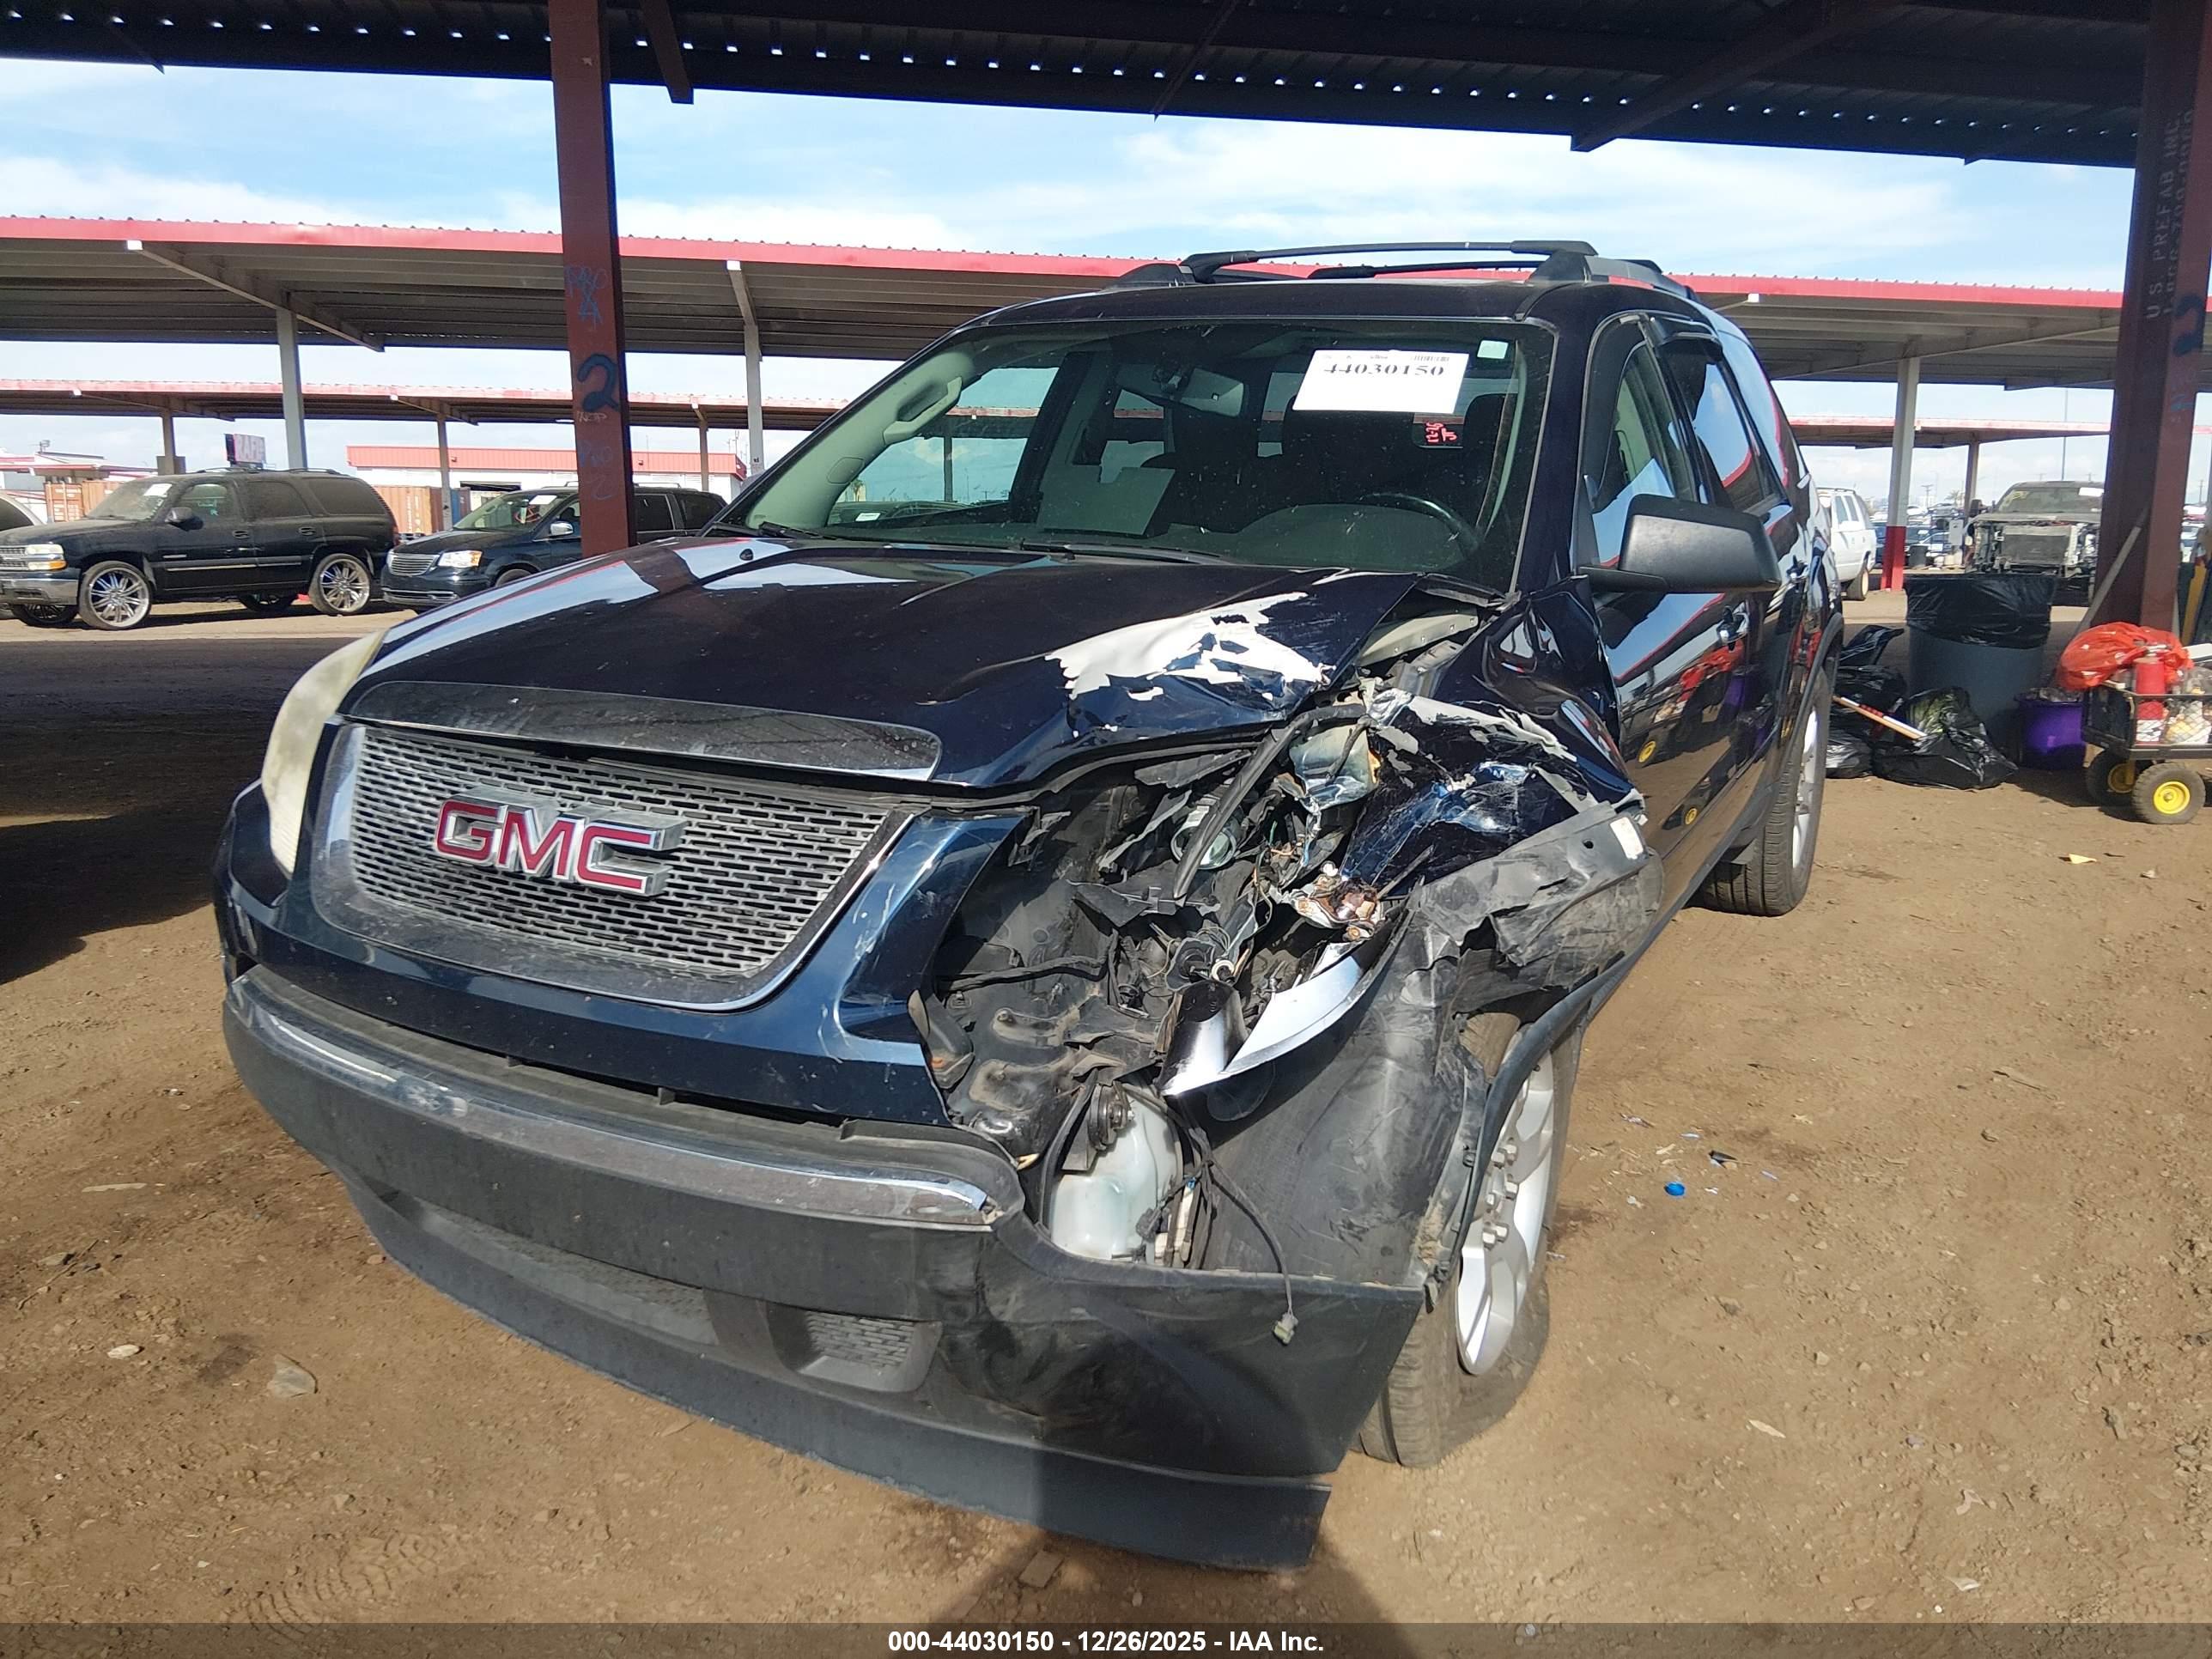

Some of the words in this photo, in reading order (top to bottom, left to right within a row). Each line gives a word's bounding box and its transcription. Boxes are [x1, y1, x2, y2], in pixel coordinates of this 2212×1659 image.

[2151, 171, 2175, 262] PREFAB
[576, 353, 620, 412] 2
[1323, 363, 1444, 377] 44030150
[434, 792, 685, 896] GMC
